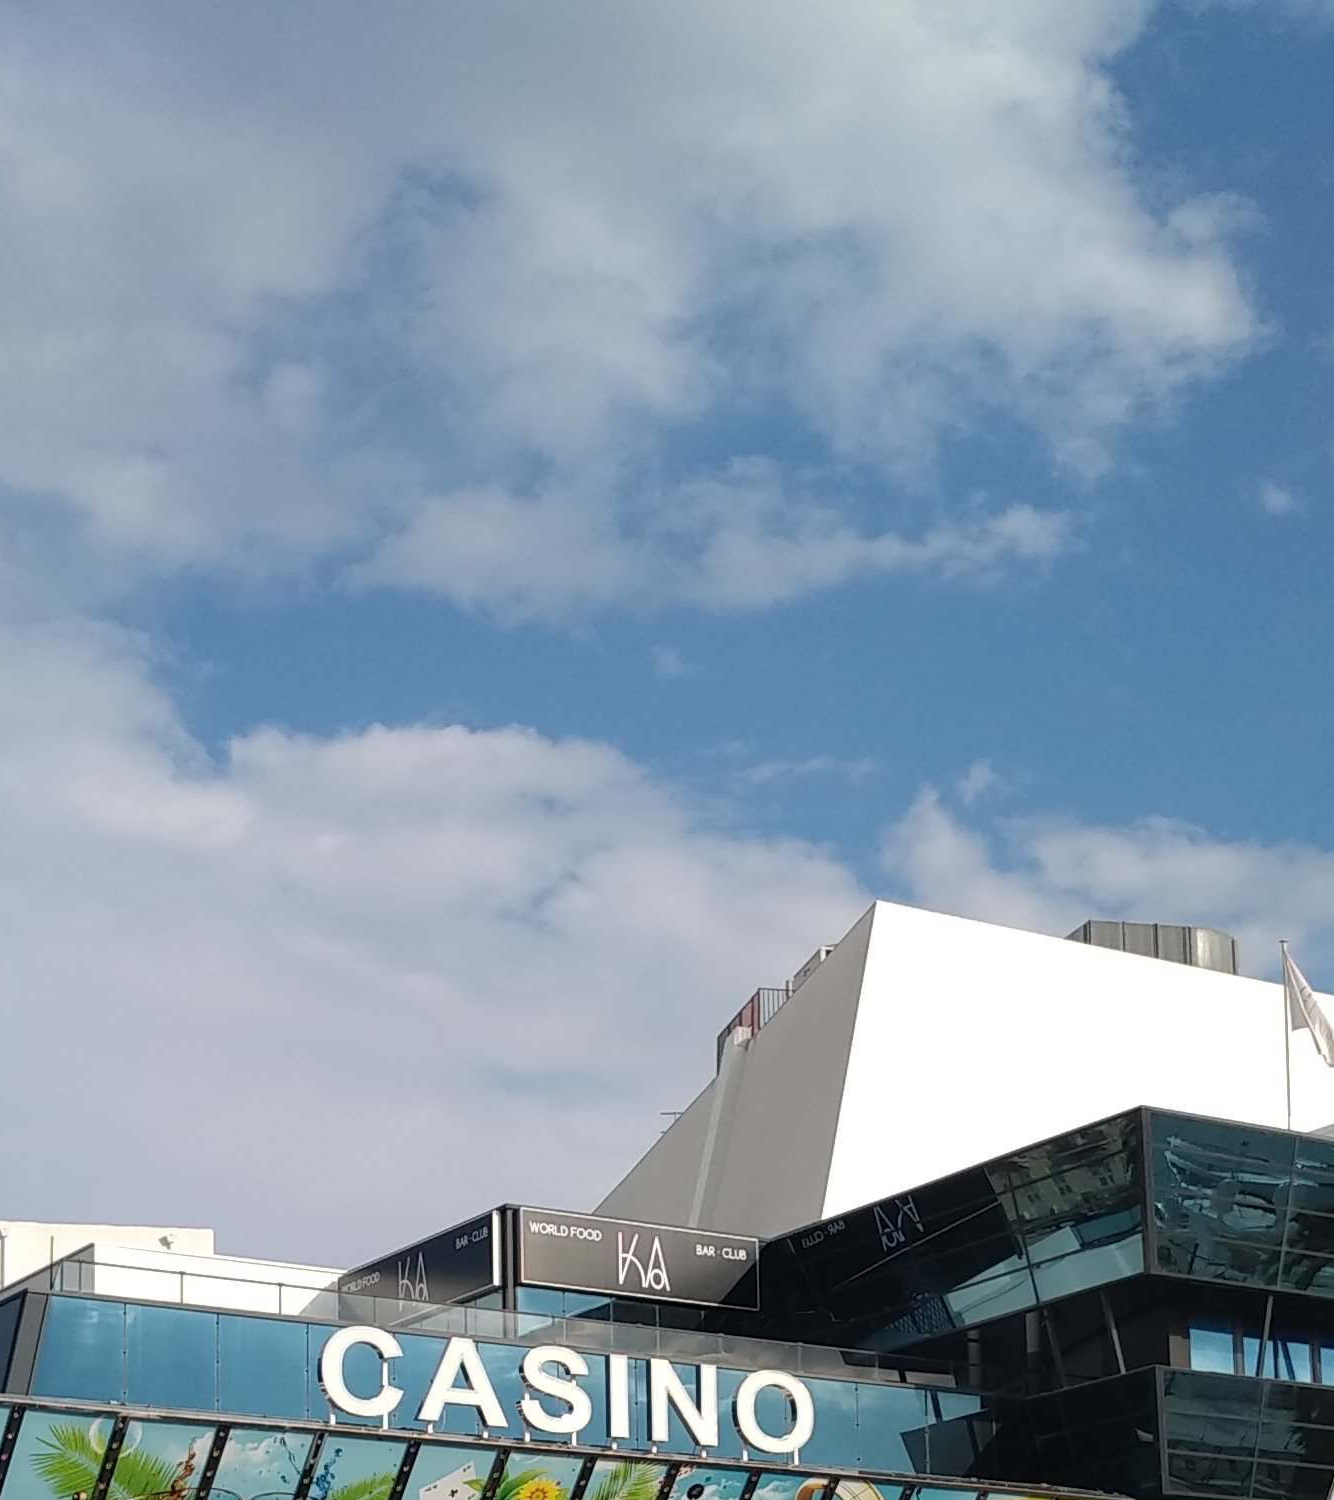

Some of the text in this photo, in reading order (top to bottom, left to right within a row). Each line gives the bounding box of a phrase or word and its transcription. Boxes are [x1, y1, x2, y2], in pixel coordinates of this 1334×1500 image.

[455, 1226, 489, 1250] BAR CLUB
[528, 1220, 602, 1241] WORLD FOOD
[695, 1244, 747, 1261] BAR CLUB
[362, 1271, 381, 1287] FOOD
[317, 1324, 815, 1454] CASINO
